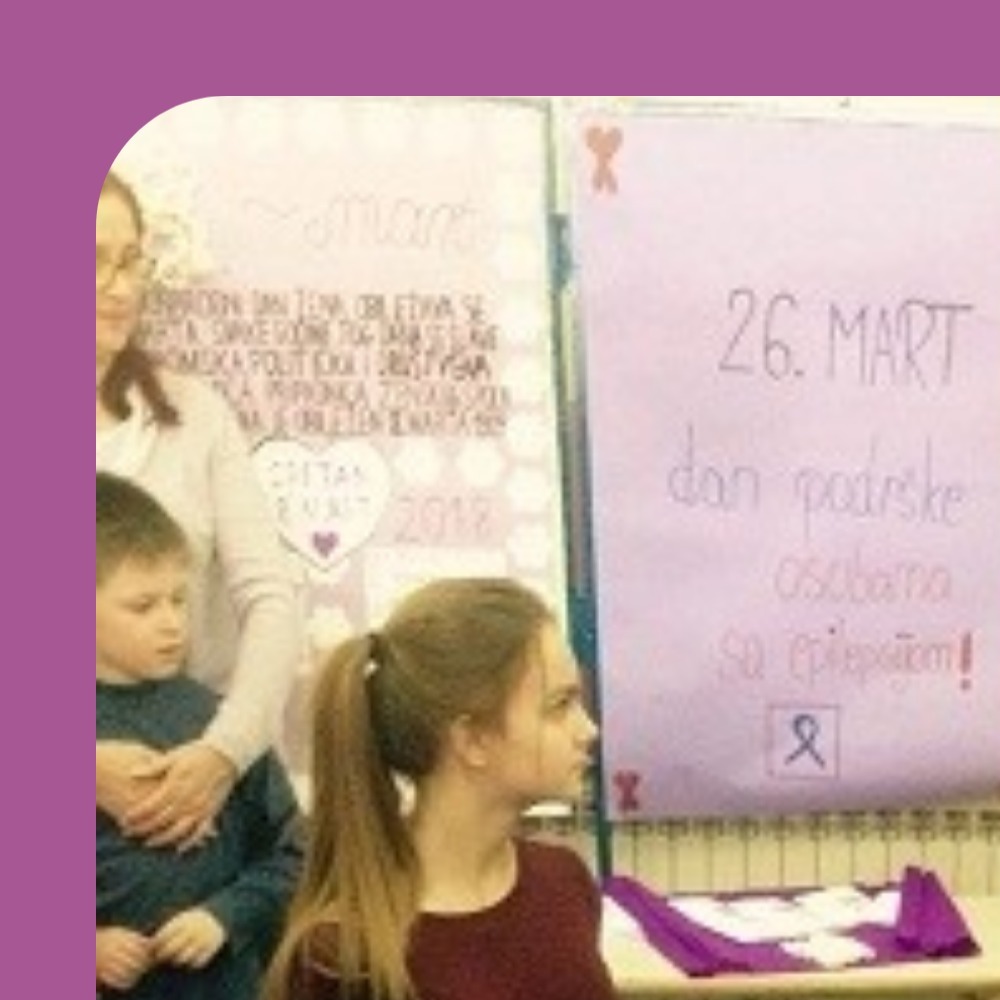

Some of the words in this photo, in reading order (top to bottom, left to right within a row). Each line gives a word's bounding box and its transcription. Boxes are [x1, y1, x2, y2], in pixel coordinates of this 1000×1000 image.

[718, 287, 805, 380] 26.
[828, 299, 975, 390] MART
[666, 420, 759, 510] dan
